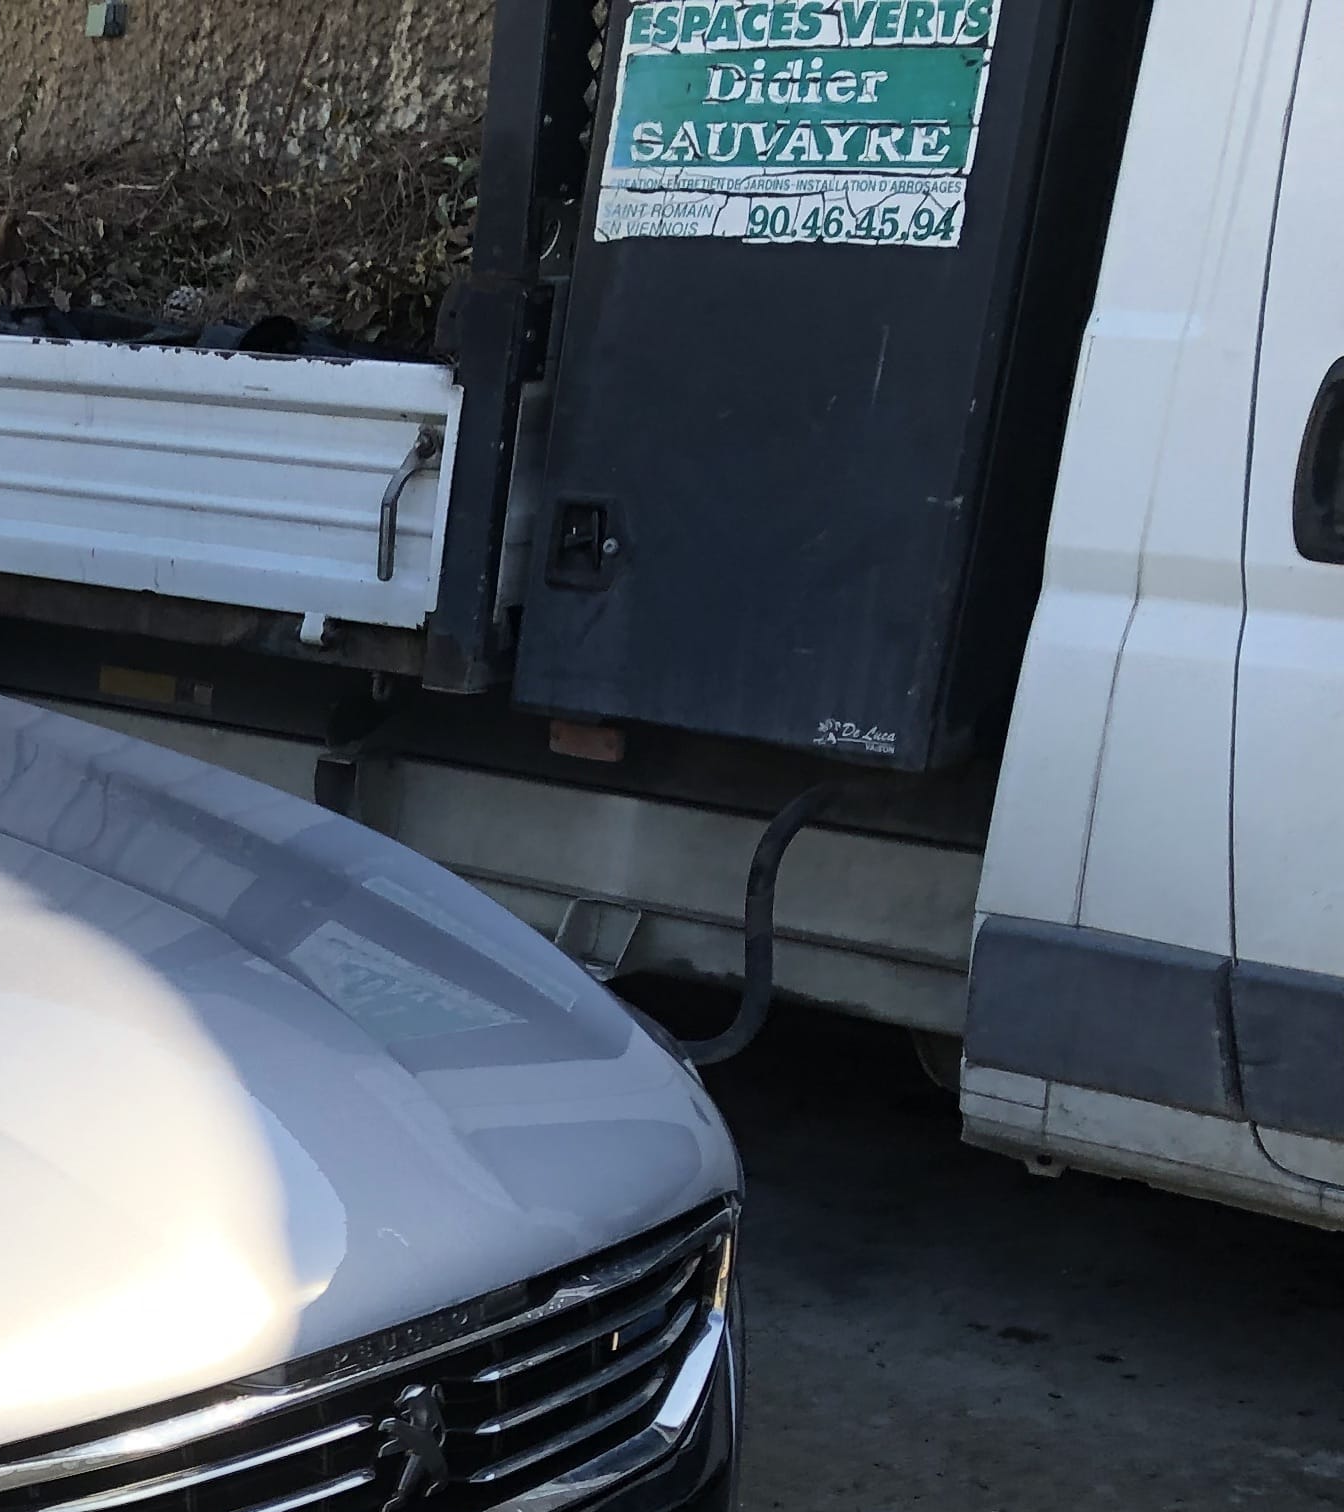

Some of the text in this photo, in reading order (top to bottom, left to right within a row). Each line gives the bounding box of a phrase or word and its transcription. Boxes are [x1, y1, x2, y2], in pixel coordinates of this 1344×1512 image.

[629, 0, 993, 45] ESPACES VERTS
[703, 57, 889, 105] Didier
[630, 119, 951, 162] SAUVAYRE
[604, 203, 714, 218] SAINT ROMAIN
[627, 222, 699, 237] VIENNOIS
